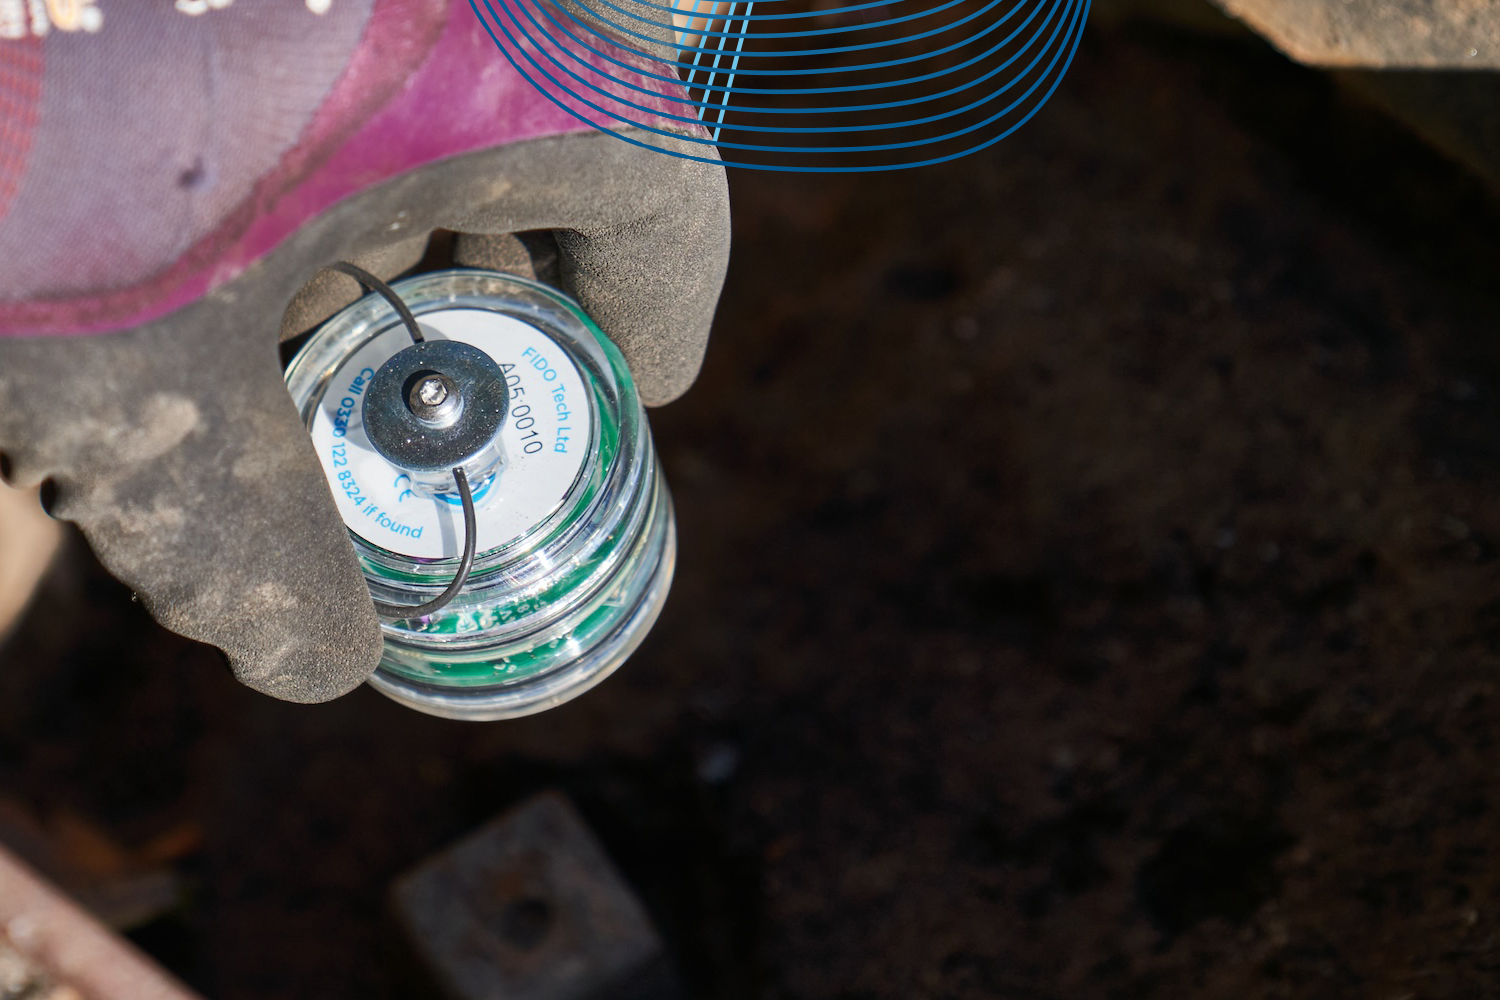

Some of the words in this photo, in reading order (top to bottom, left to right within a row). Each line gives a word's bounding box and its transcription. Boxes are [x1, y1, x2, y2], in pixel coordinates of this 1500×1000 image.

[521, 346, 557, 382] FIDO
[348, 367, 375, 396] Call
[551, 383, 571, 422] Tech
[332, 397, 355, 438] 0330
[332, 442, 348, 468] 122
[553, 427, 572, 454] Ltd
[337, 470, 367, 507] 8324
[363, 503, 378, 517] if
[374, 512, 424, 540] found
